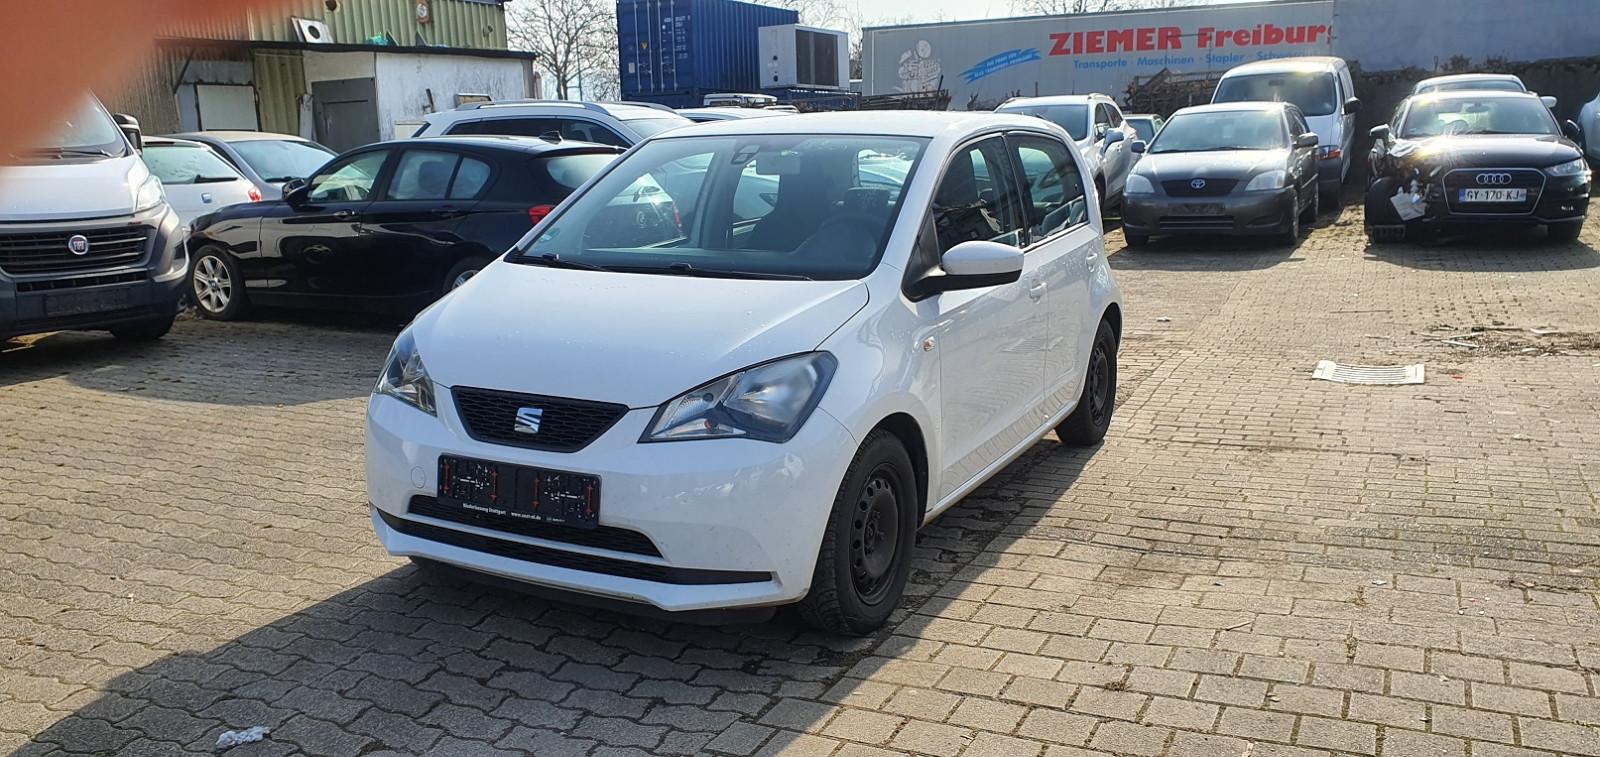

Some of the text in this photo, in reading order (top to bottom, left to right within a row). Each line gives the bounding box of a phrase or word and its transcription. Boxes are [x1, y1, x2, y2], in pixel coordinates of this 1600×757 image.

[1048, 26, 1182, 56] ZIEMER
[1073, 59, 1128, 71] Transporte
[1136, 55, 1194, 67] Maschinen
[1205, 52, 1245, 65] Stapler
